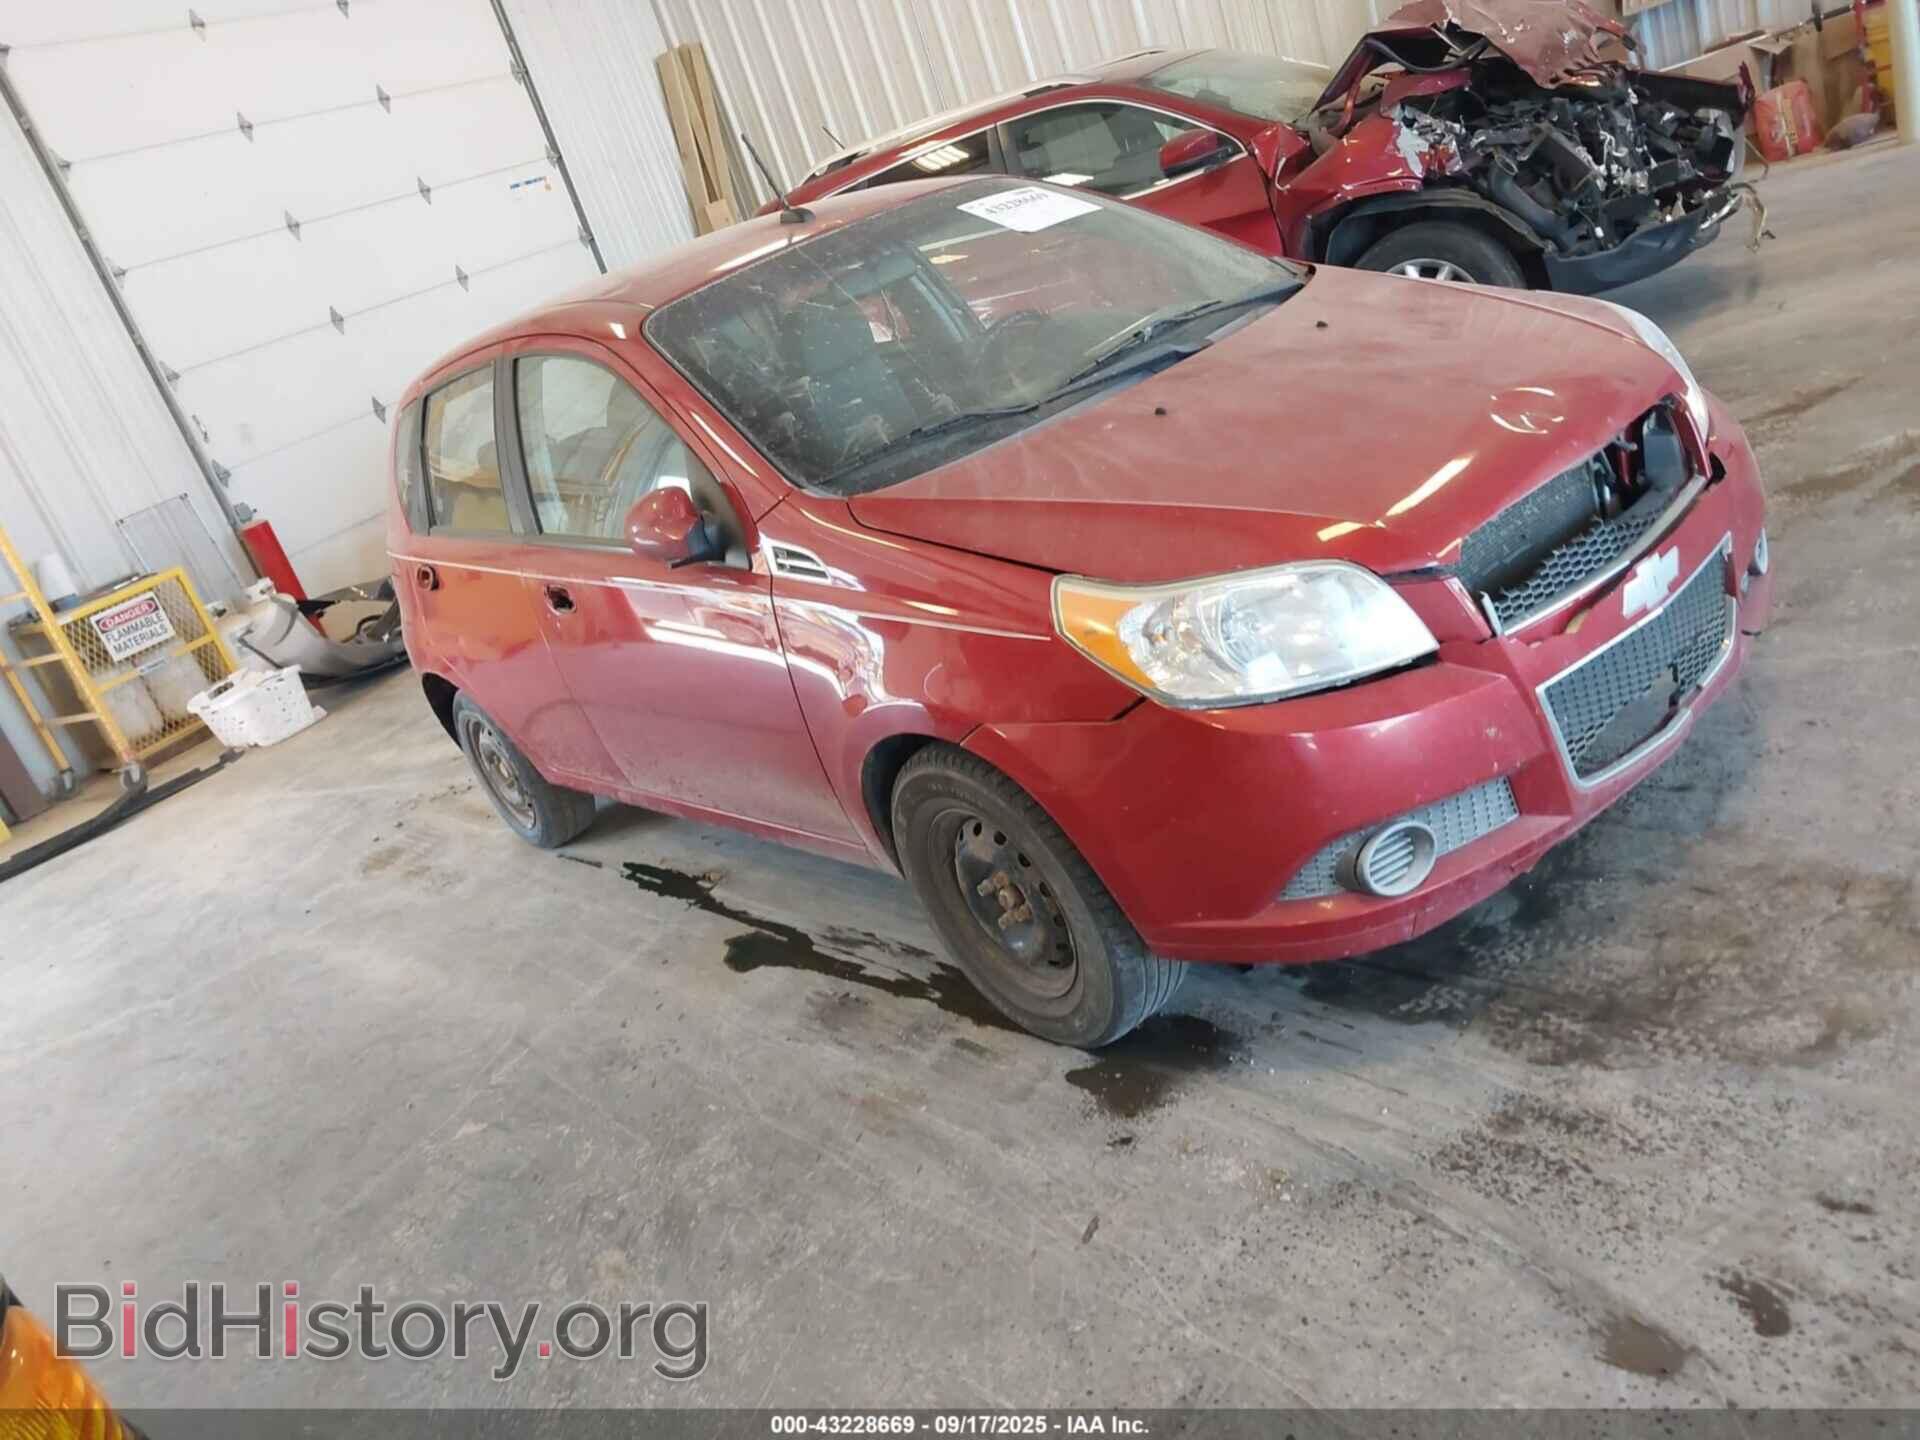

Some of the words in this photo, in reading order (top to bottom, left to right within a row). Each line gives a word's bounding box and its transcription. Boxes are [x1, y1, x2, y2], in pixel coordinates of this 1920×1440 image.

[105, 601, 151, 628] DANGER
[105, 611, 164, 643] FLAMMABLE
[113, 624, 168, 652] MATERIALS
